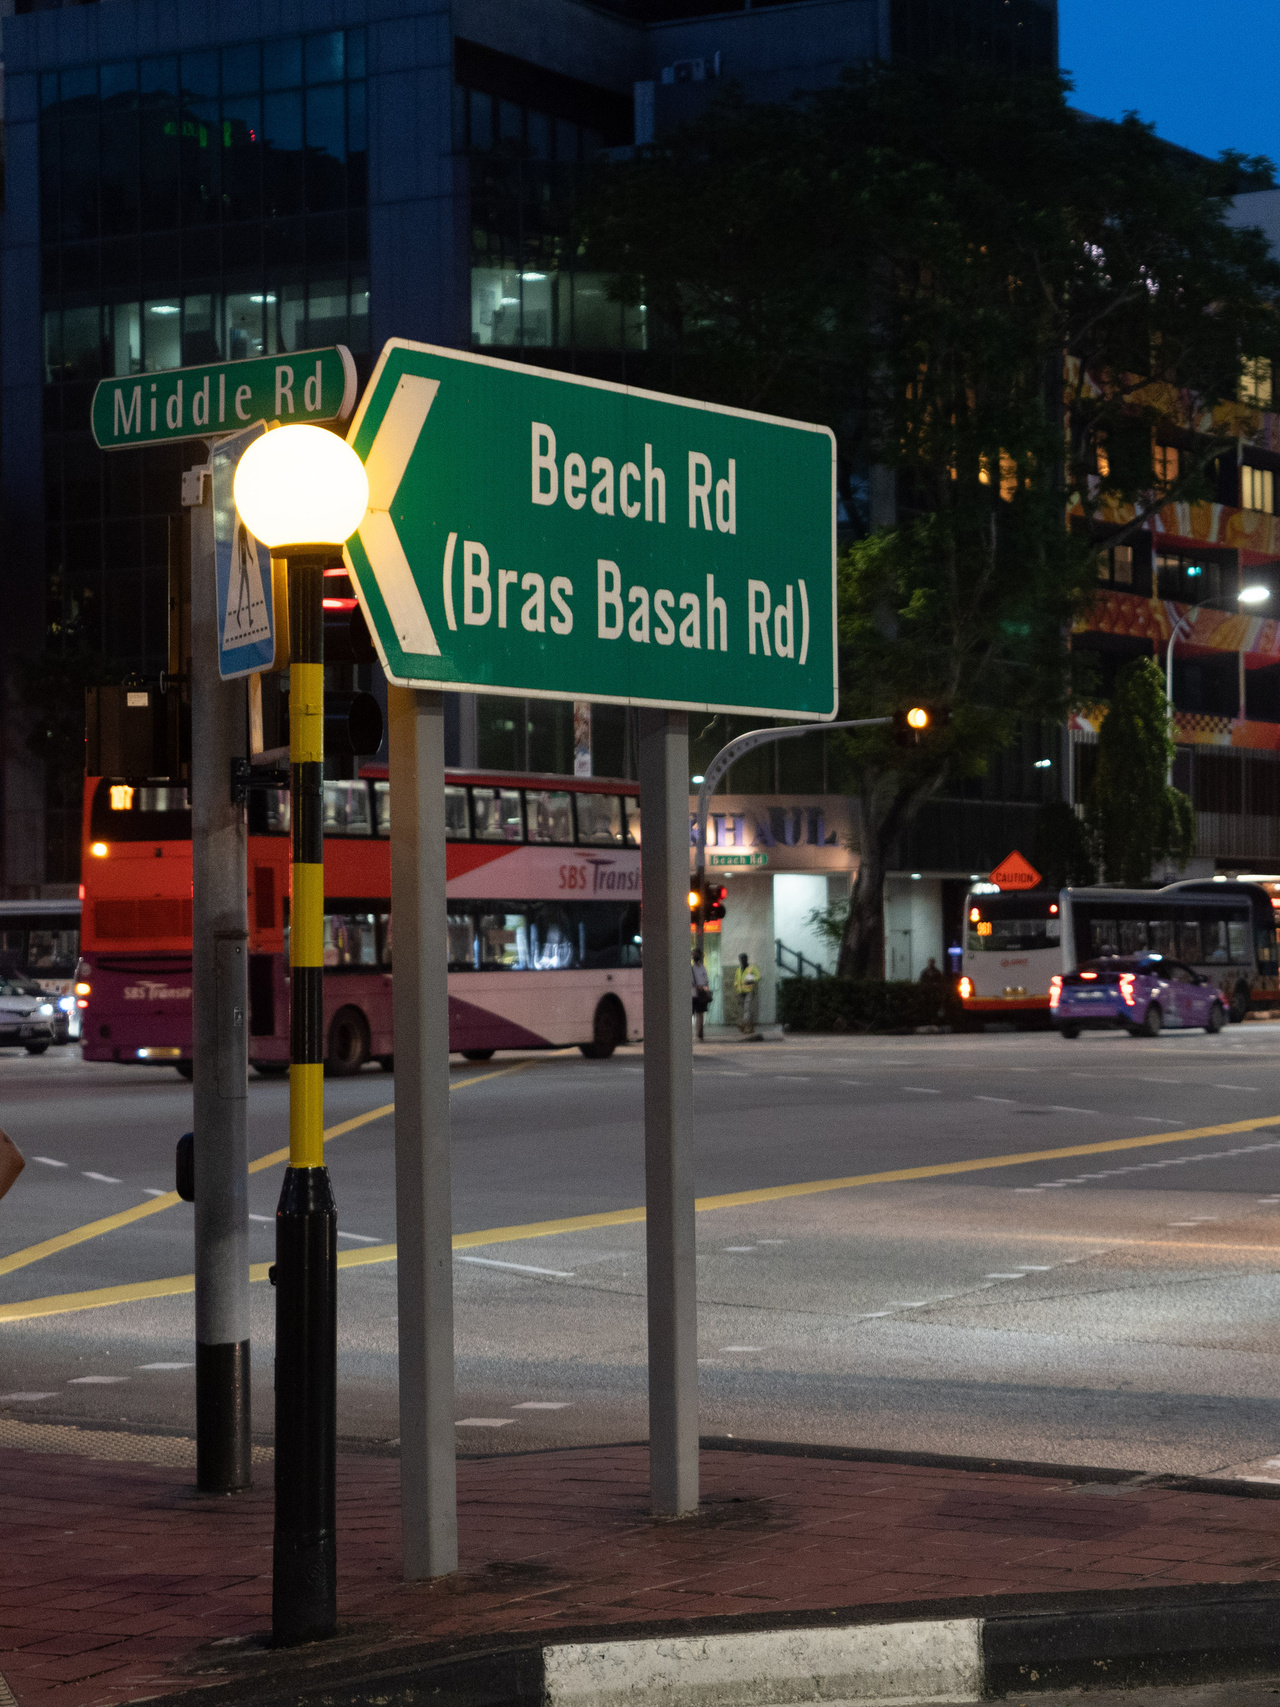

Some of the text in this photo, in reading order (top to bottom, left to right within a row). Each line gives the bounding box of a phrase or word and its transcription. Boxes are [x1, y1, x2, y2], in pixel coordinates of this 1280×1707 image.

[113, 360, 323, 437] Middle Rd
[531, 421, 737, 535] Beach Rd
[442, 531, 810, 665] (Bras Basah Rd)
[558, 858, 640, 895] SBS Transi
[713, 853, 764, 866] Beach Rd
[995, 871, 1035, 884] CAUTION
